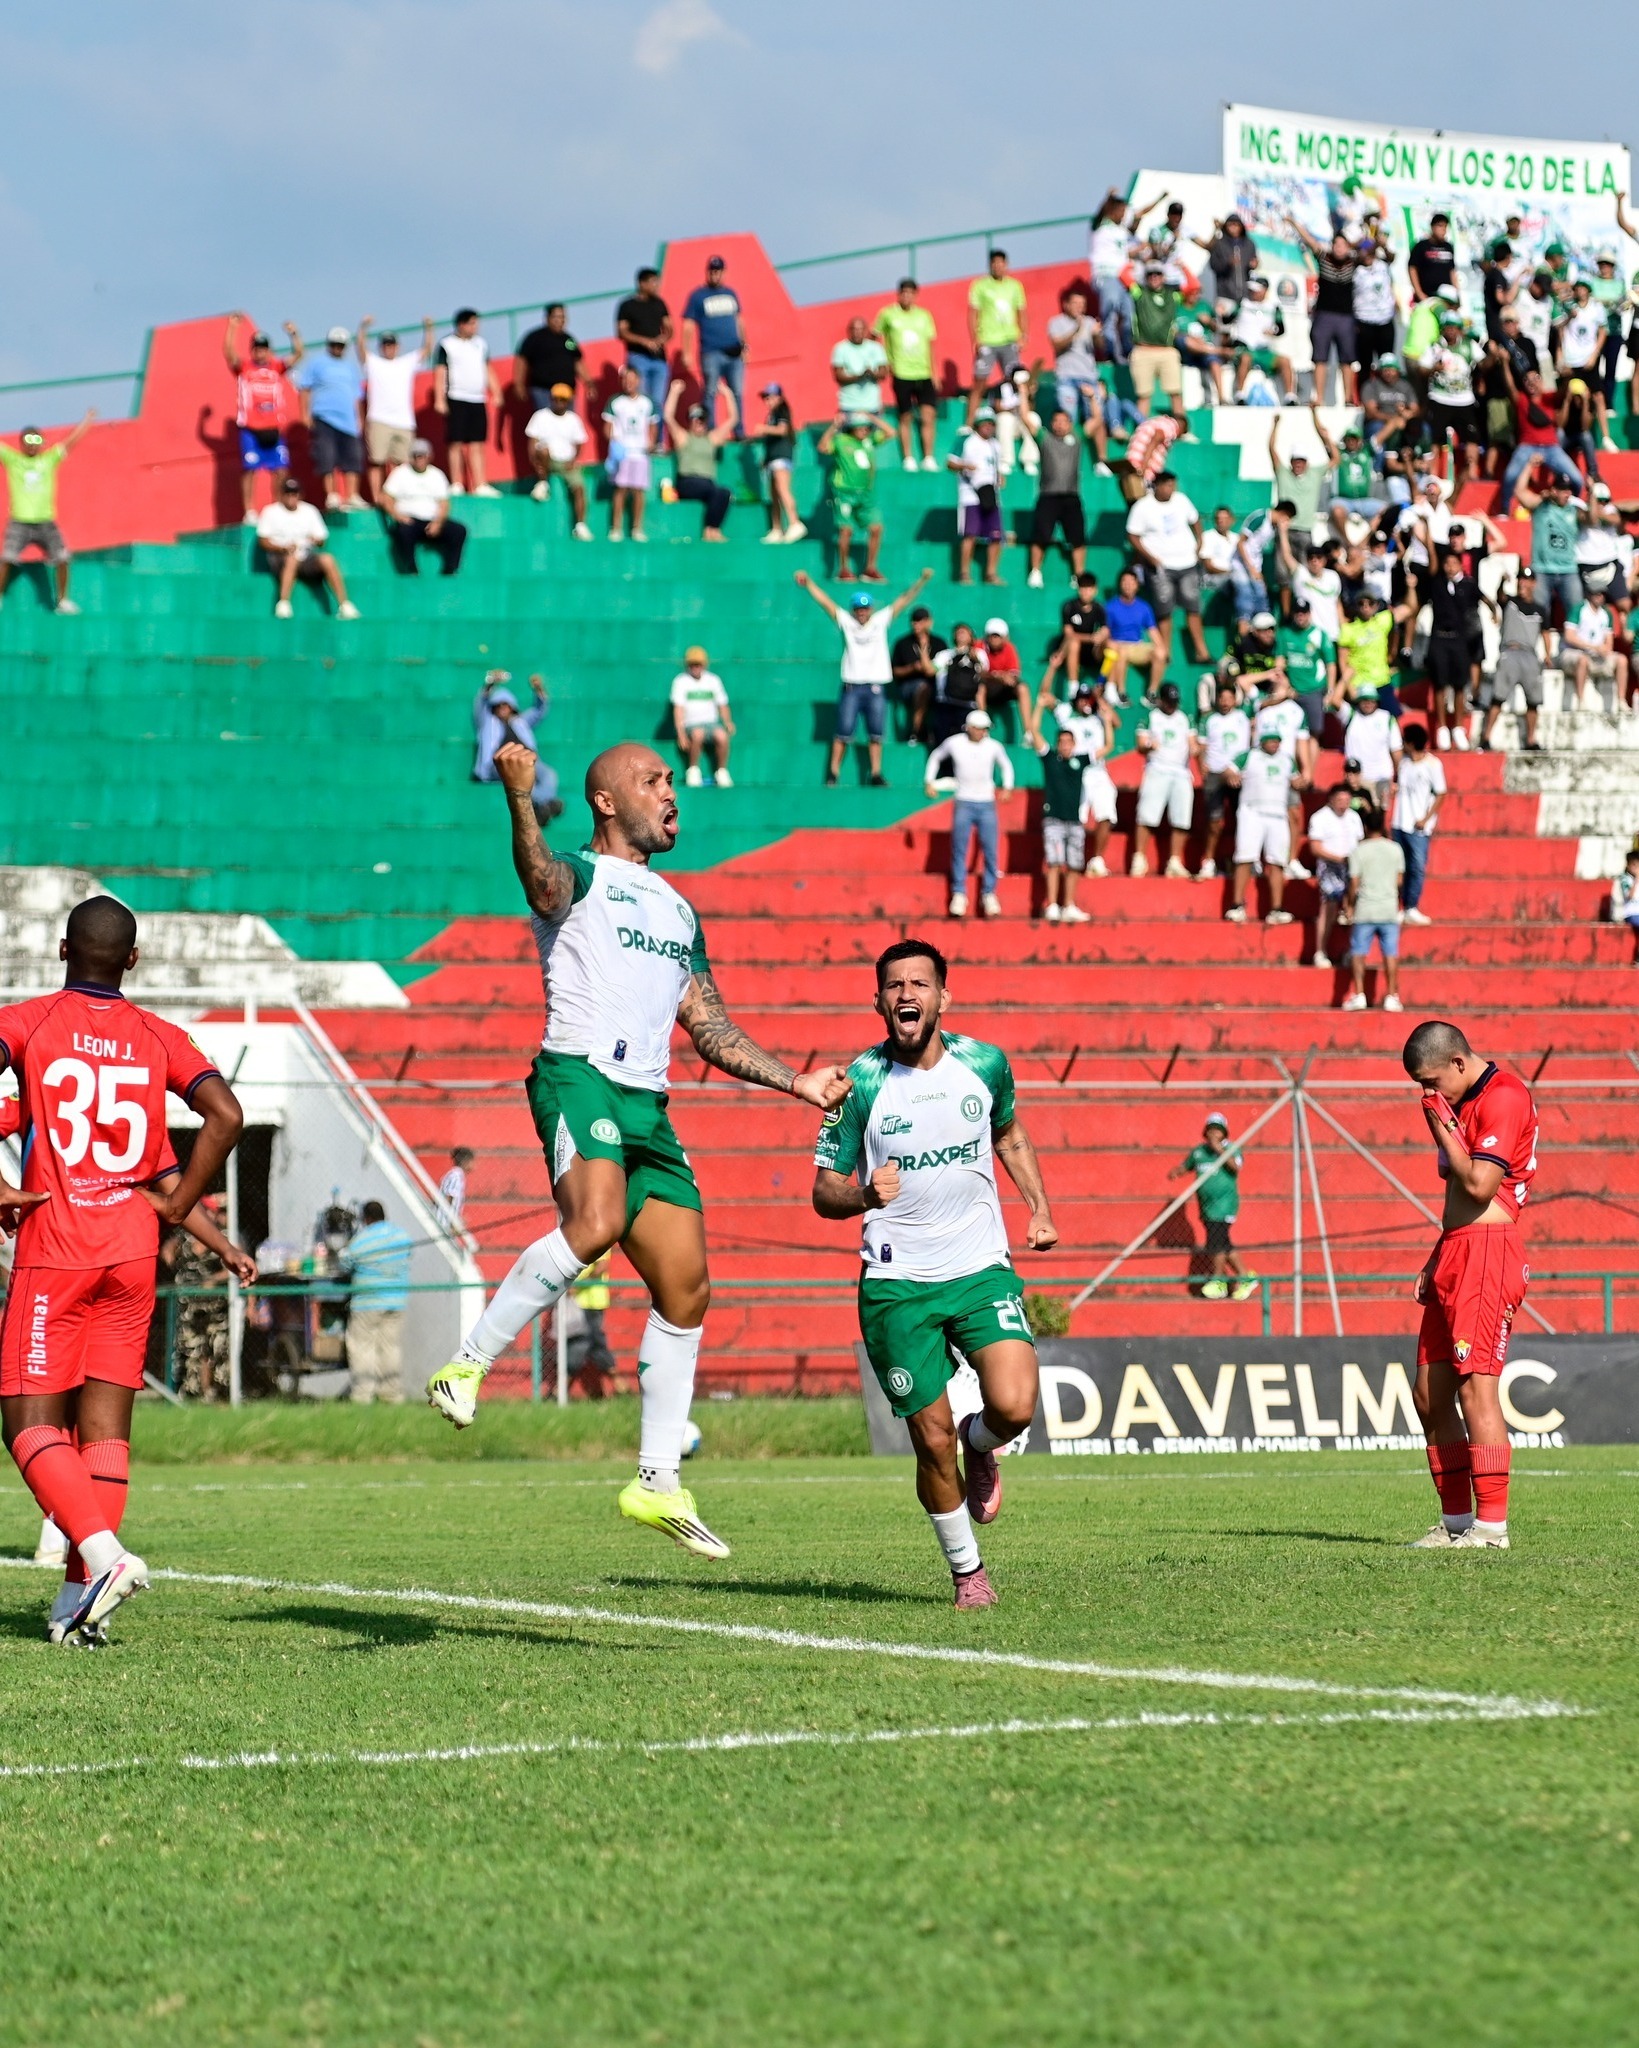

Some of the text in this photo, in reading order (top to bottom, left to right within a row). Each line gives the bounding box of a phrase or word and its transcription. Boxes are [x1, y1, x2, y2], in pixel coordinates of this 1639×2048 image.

[1240, 122, 1617, 195] ING. MOREJÓN Y LOS 20 DE LA
[616, 926, 692, 962] DRAXBE
[73, 1032, 136, 1061] LEON J.
[42, 1057, 150, 1173] 35
[27, 1293, 49, 1376] Fibramax
[1038, 1358, 1566, 1439] DAVELMC
